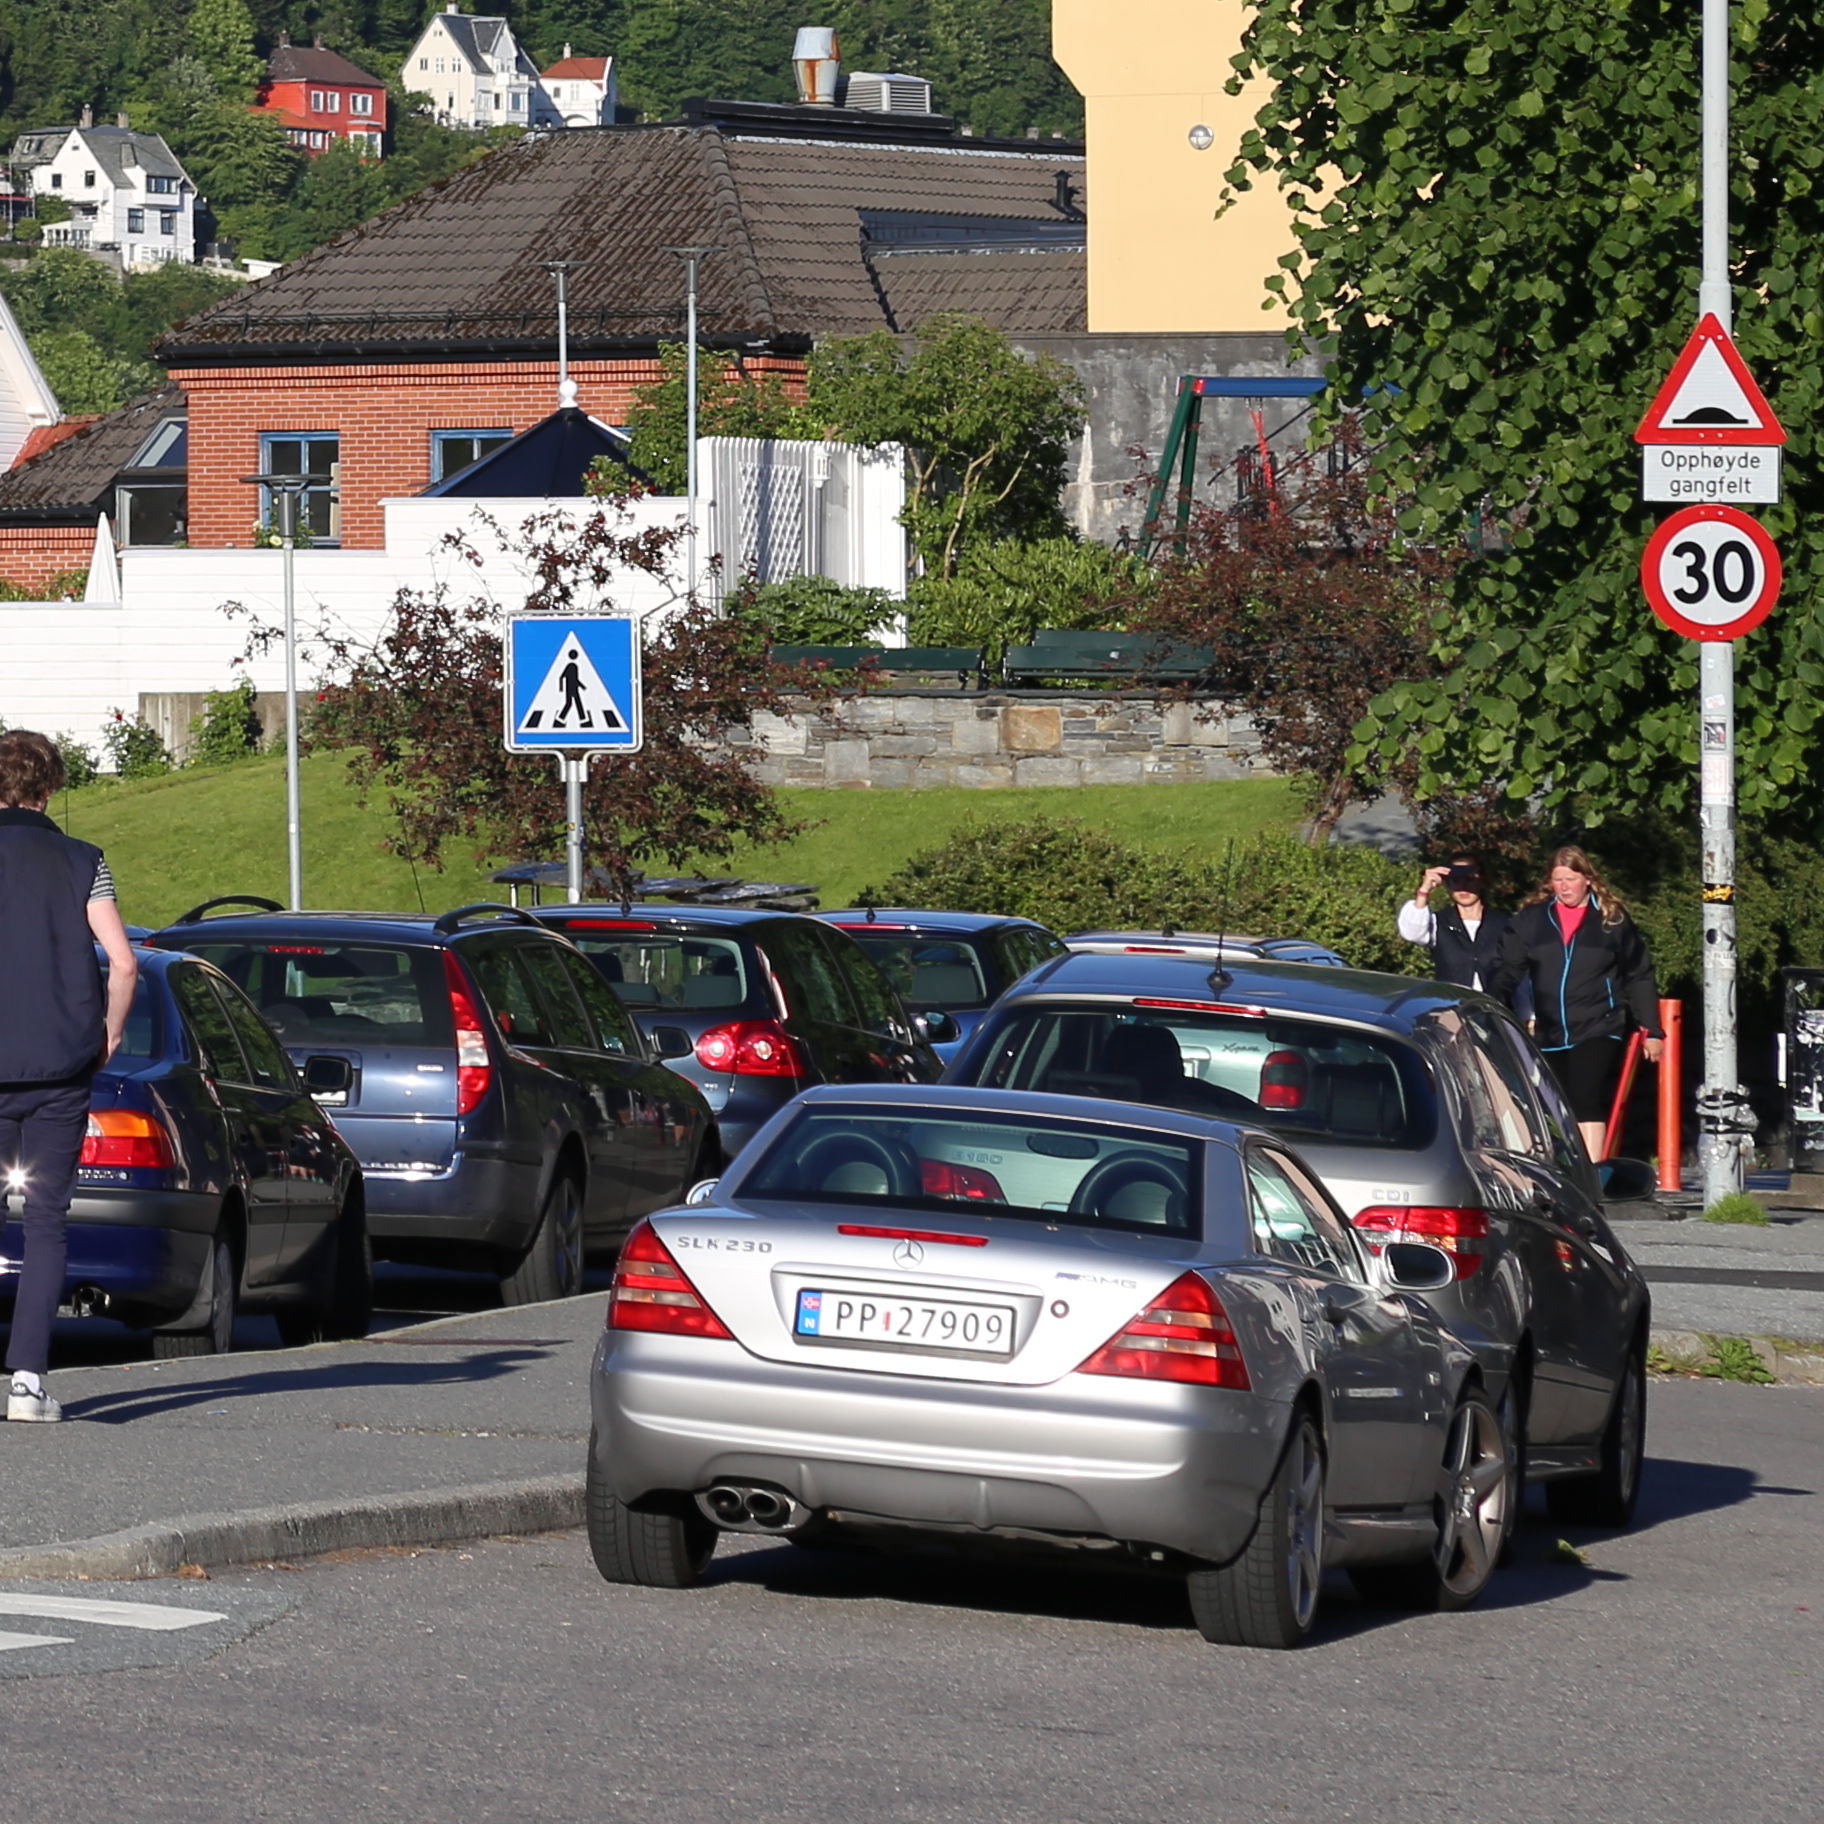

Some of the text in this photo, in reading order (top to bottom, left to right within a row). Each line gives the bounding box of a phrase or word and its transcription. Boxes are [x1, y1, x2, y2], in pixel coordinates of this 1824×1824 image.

[1661, 450, 1760, 473] Opphøyde
[1670, 476, 1752, 497] gangfelt
[1672, 540, 1755, 604] 30
[677, 1236, 773, 1253] SLK 230
[836, 1300, 877, 1333] PP
[896, 1306, 1004, 1345] 27909
